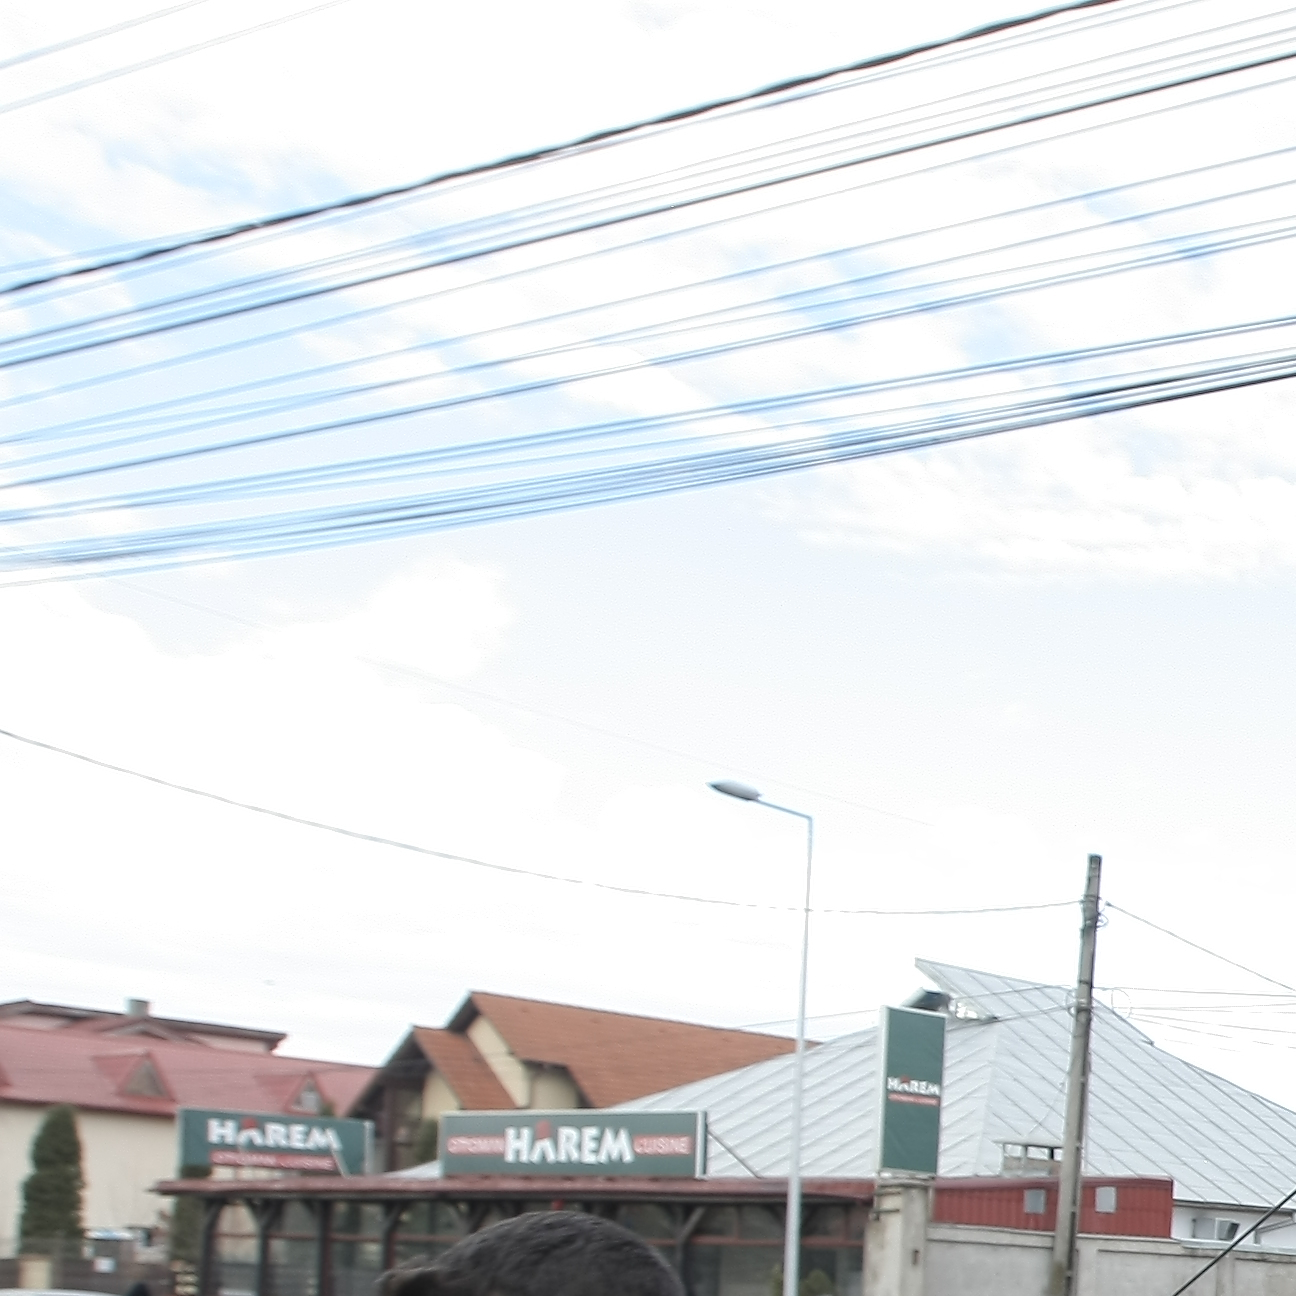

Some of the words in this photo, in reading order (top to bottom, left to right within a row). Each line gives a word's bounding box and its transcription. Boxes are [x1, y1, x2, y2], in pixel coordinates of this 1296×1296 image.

[886, 1075, 941, 1097] HAREM
[207, 1117, 342, 1150] HAREM
[504, 1120, 634, 1164] HAREM
